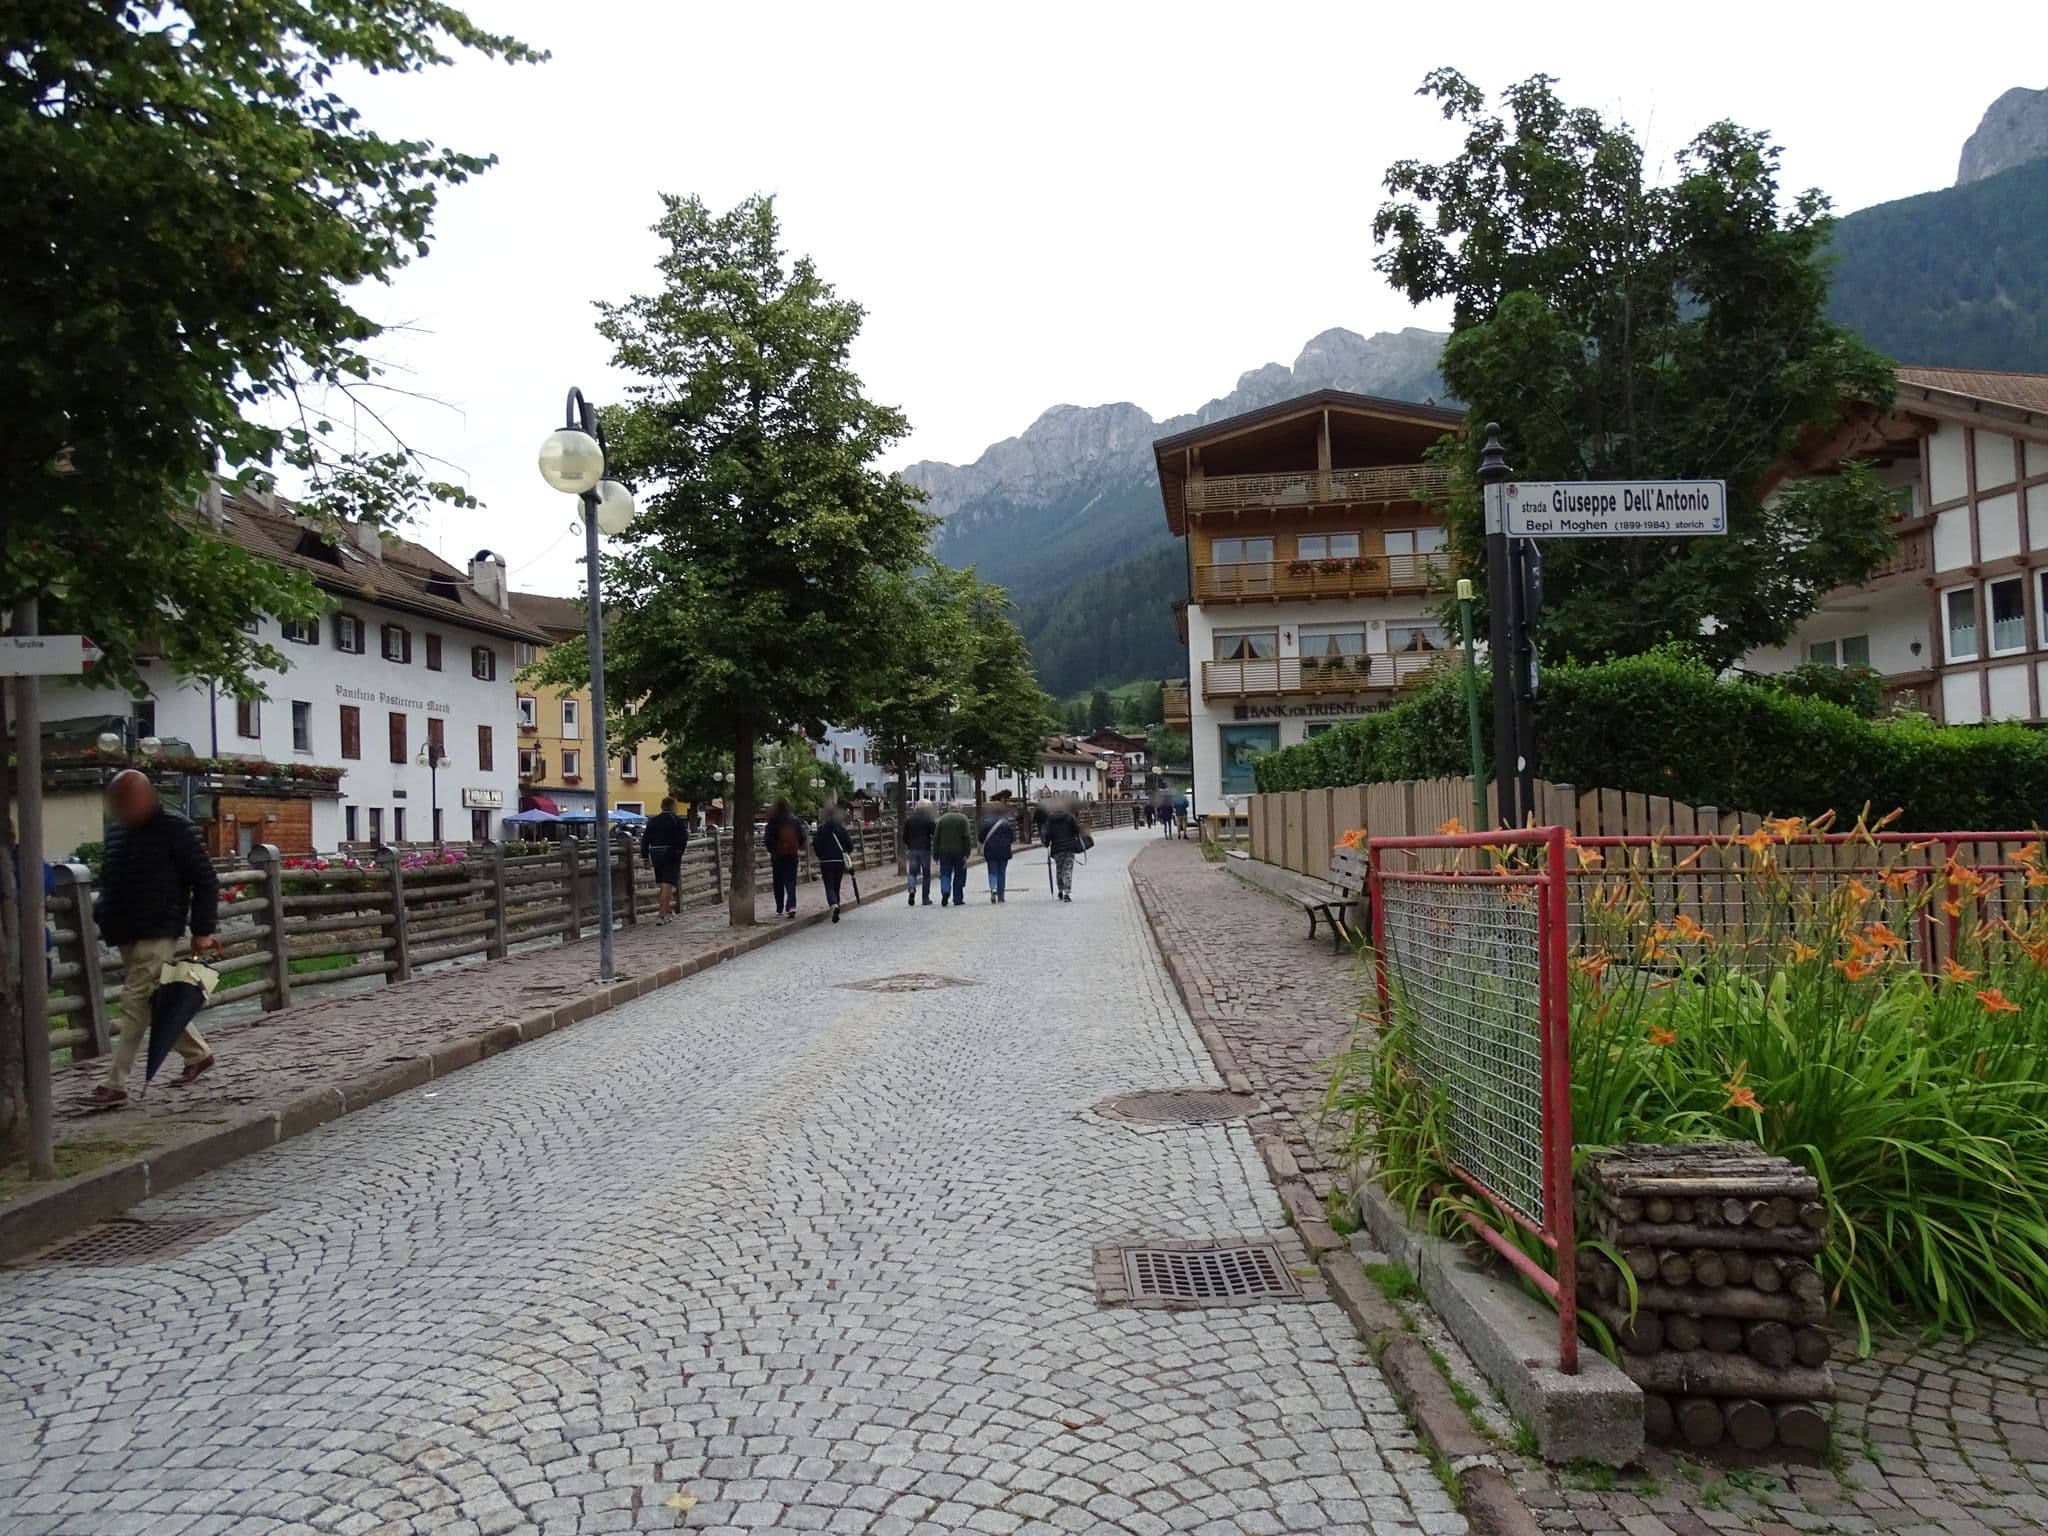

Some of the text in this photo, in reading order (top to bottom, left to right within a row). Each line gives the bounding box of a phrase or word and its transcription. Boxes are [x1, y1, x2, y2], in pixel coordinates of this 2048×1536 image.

[1521, 488, 1709, 516] strada Giuseppe Dell'Antonio
[1526, 519, 1704, 532] Bepi Moghen (1899-1984) storich
[335, 684, 375, 702] Panificio
[379, 691, 423, 709] Pasticceria
[1250, 704, 1287, 718] BANK
[1307, 702, 1356, 716] TRIENT
